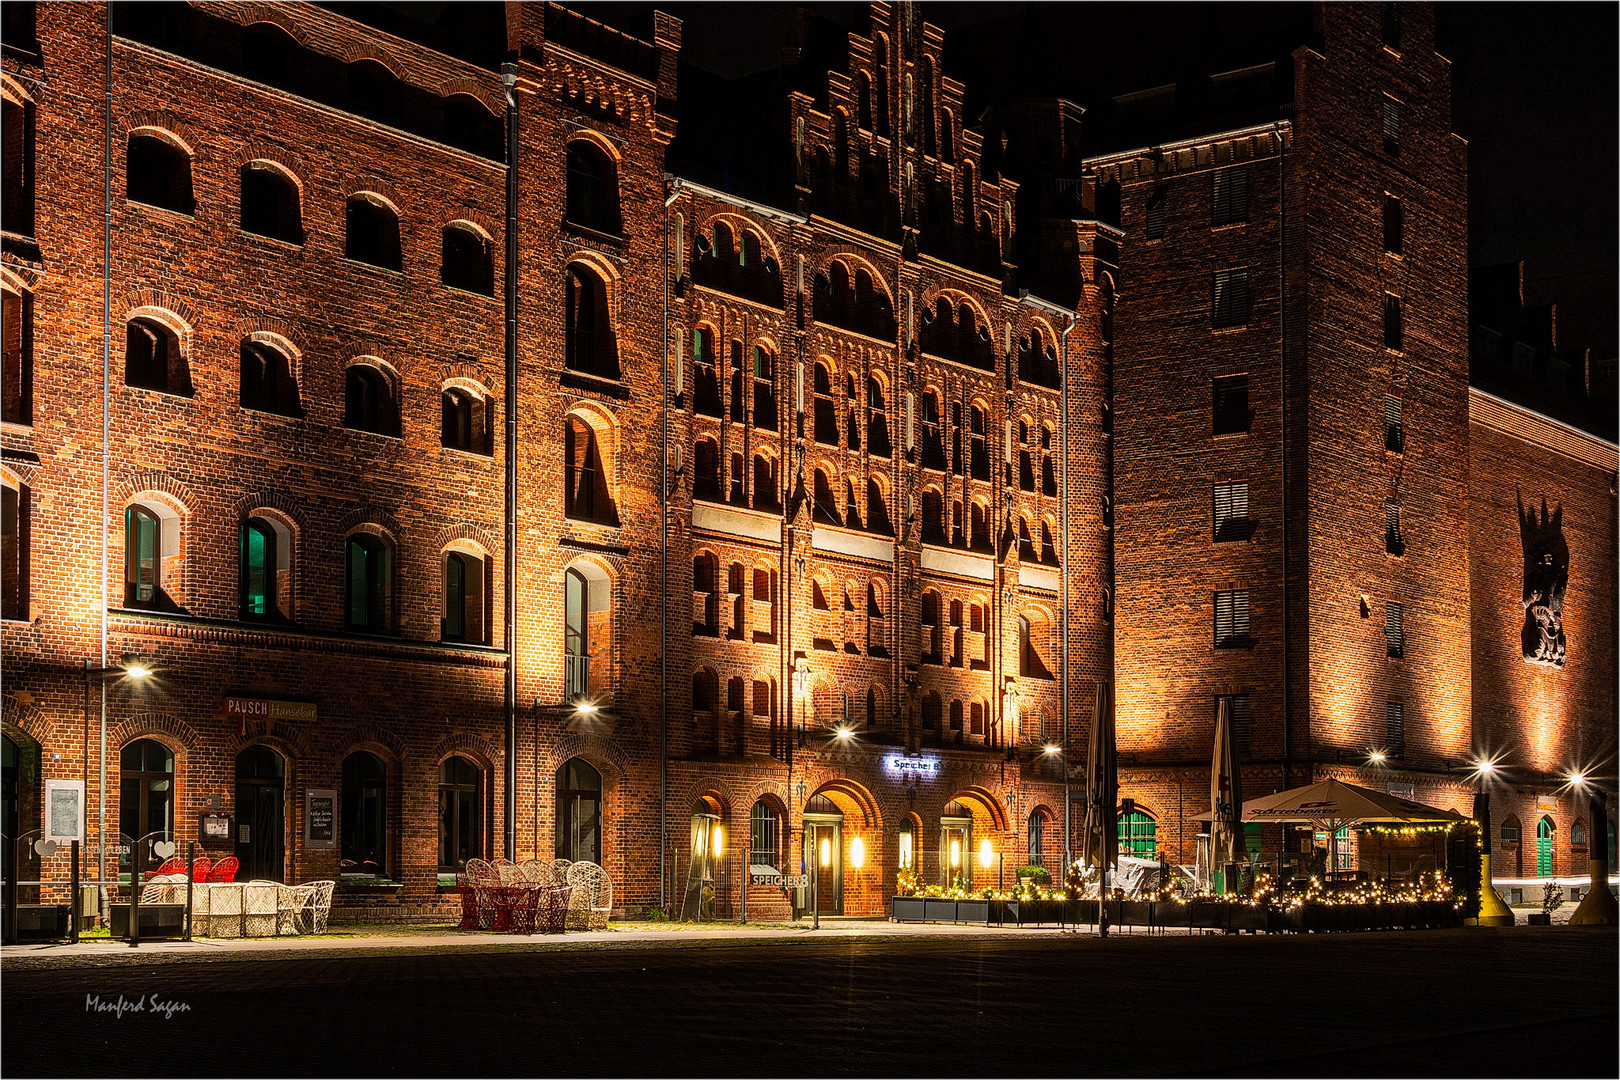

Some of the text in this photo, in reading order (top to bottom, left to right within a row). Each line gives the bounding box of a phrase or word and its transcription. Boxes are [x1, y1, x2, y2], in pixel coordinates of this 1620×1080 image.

[228, 700, 316, 718] PAUSCH Hansebar
[753, 873, 808, 888] SPEICHER 8
